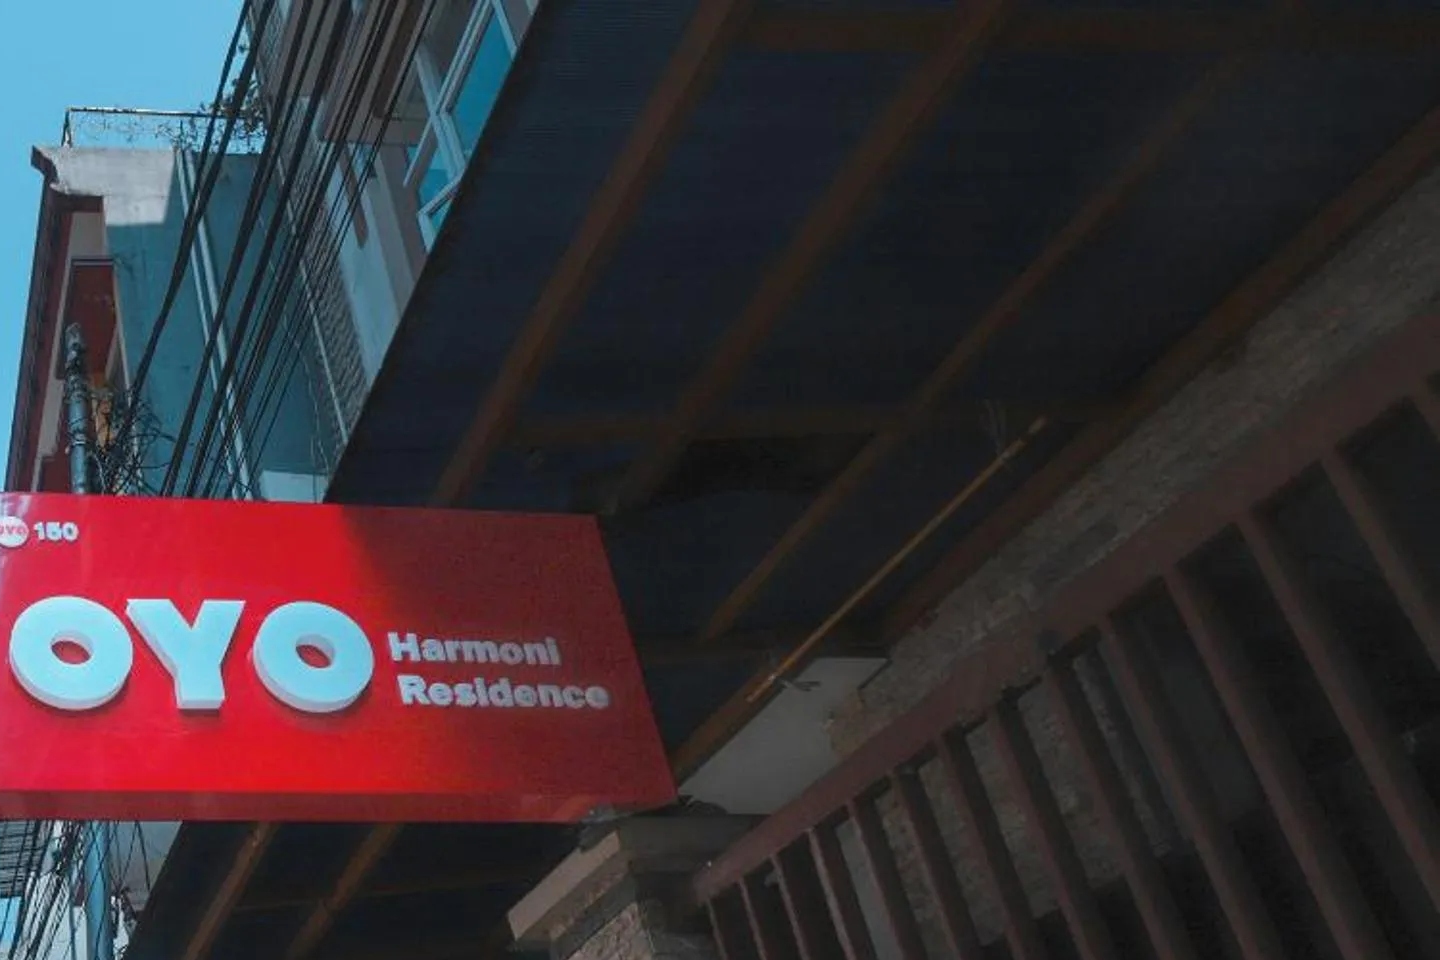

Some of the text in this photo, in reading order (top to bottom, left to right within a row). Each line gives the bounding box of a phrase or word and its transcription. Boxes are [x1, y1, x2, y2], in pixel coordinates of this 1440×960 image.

[9, 595, 374, 713] OYO
[388, 631, 561, 665] Harmoni
[397, 673, 609, 709] Residence
